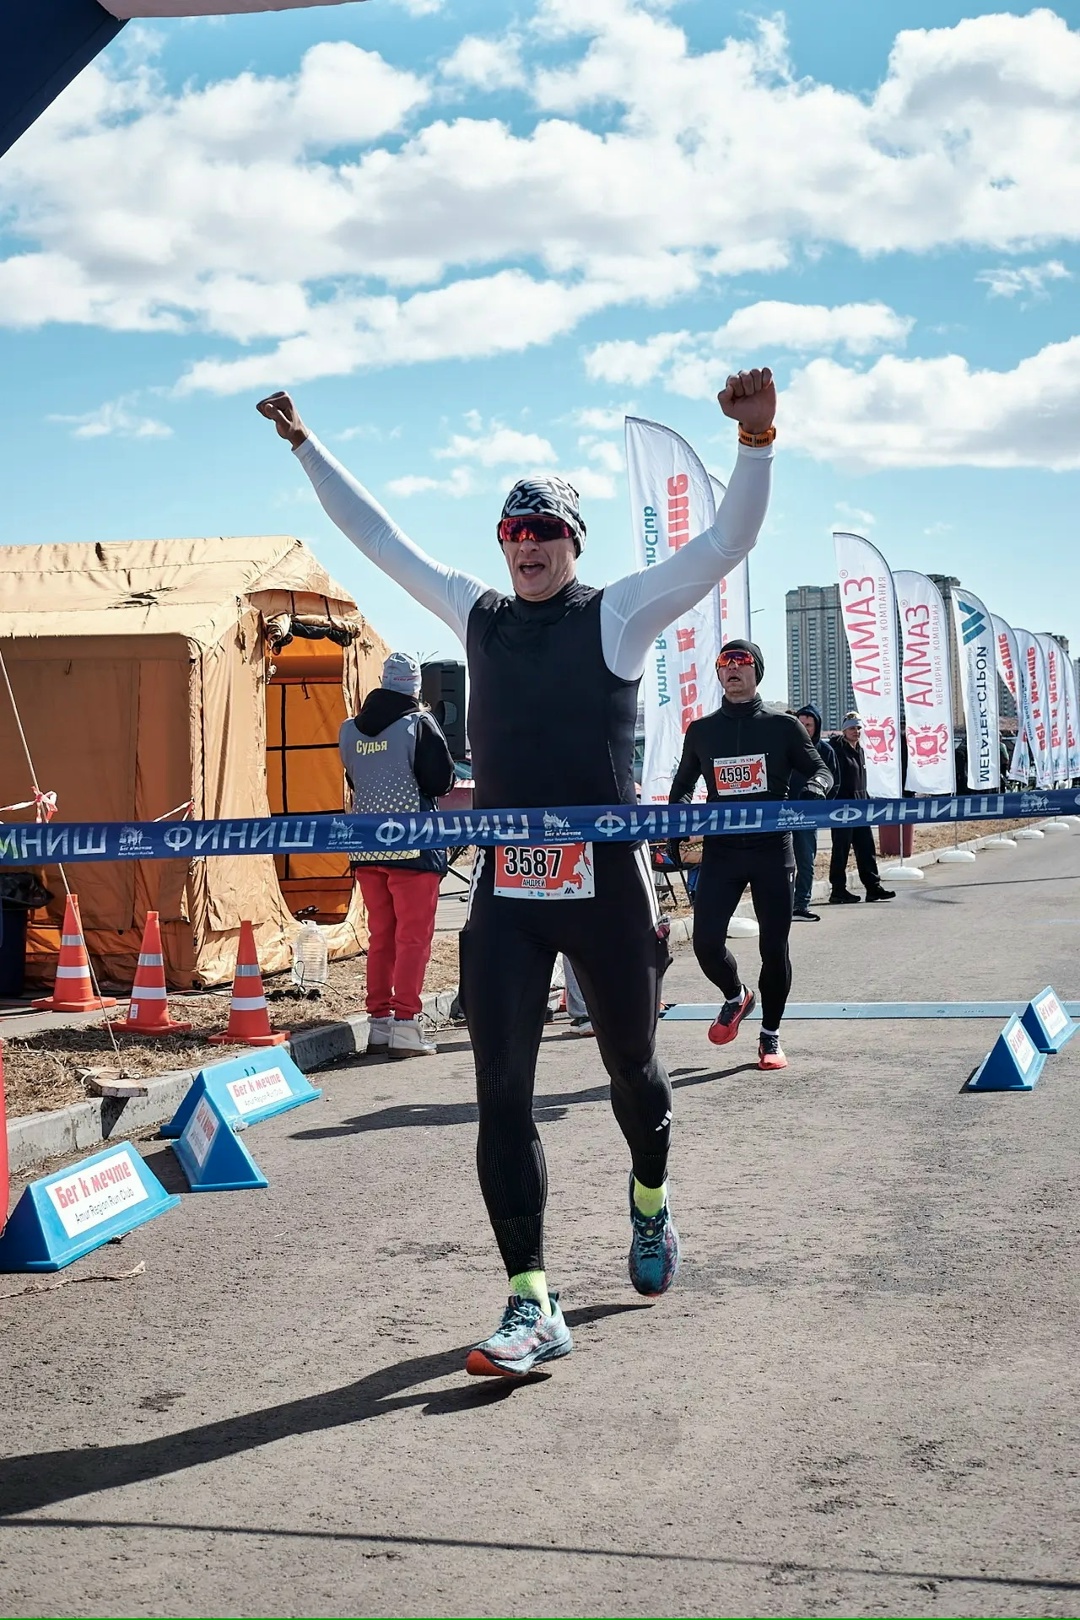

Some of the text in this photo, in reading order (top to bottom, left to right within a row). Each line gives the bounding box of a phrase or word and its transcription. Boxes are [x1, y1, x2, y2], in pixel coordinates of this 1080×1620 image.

[878, 576, 892, 696] ЮВЕЛИРНАЯ КОМПАНИЯ
[931, 604, 944, 706] ЮВЕЛИРНАЯ КОМПАНИЯ
[356, 740, 388, 755] Судья
[719, 765, 751, 783] 4595
[594, 808, 763, 837] ФИНИШ
[829, 795, 1004, 823] ФИНИШ
[163, 821, 317, 851] ФИНИШ
[375, 814, 529, 846] ФИНИШ
[504, 846, 562, 878] 3587
[522, 878, 546, 888] АНДРЕЙ
[233, 1084, 248, 1098] Бег
[255, 1074, 281, 1091] мечте
[54, 1161, 132, 1209] Бег к мечте
[75, 1186, 134, 1223] Amur Region Run Club
